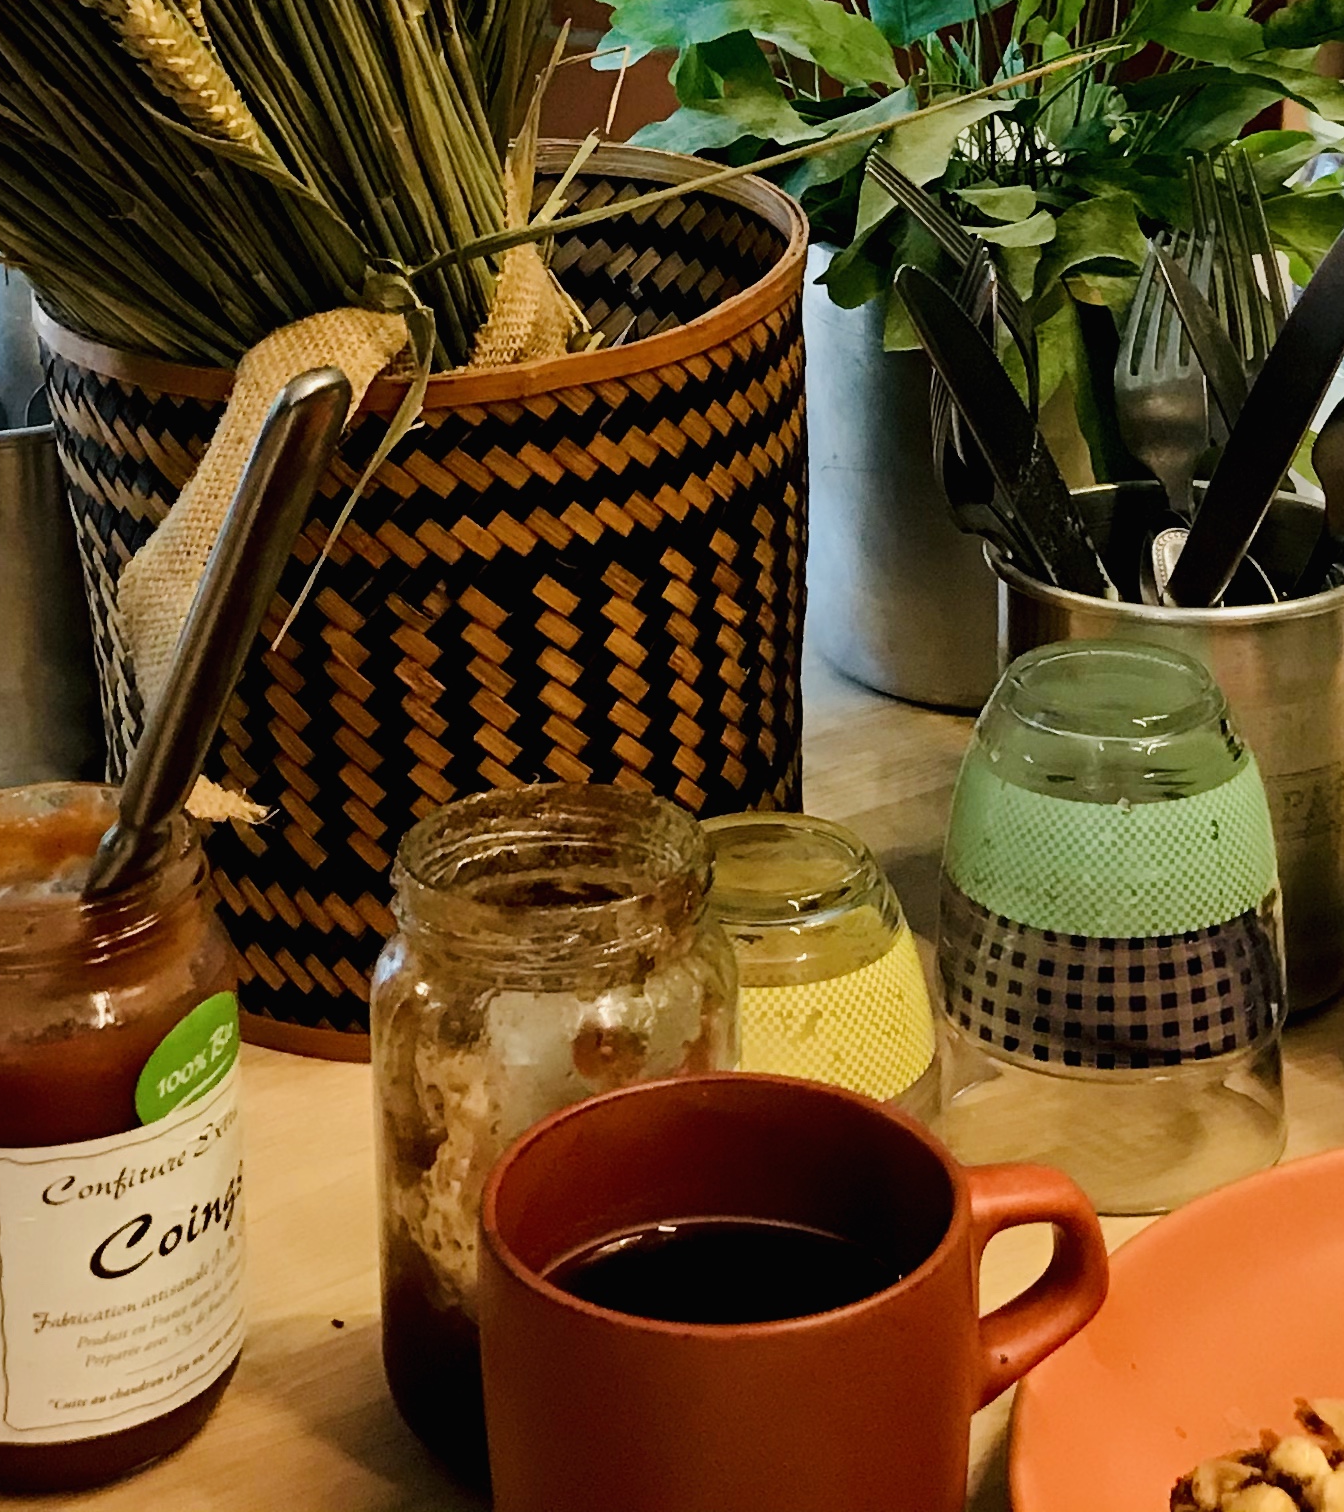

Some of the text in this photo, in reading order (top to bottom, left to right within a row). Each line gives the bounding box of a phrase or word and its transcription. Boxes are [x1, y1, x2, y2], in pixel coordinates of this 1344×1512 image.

[157, 1048, 207, 1098] 100%
[42, 1150, 187, 1206] Confiture
[32, 1303, 136, 1335] Fabrication
